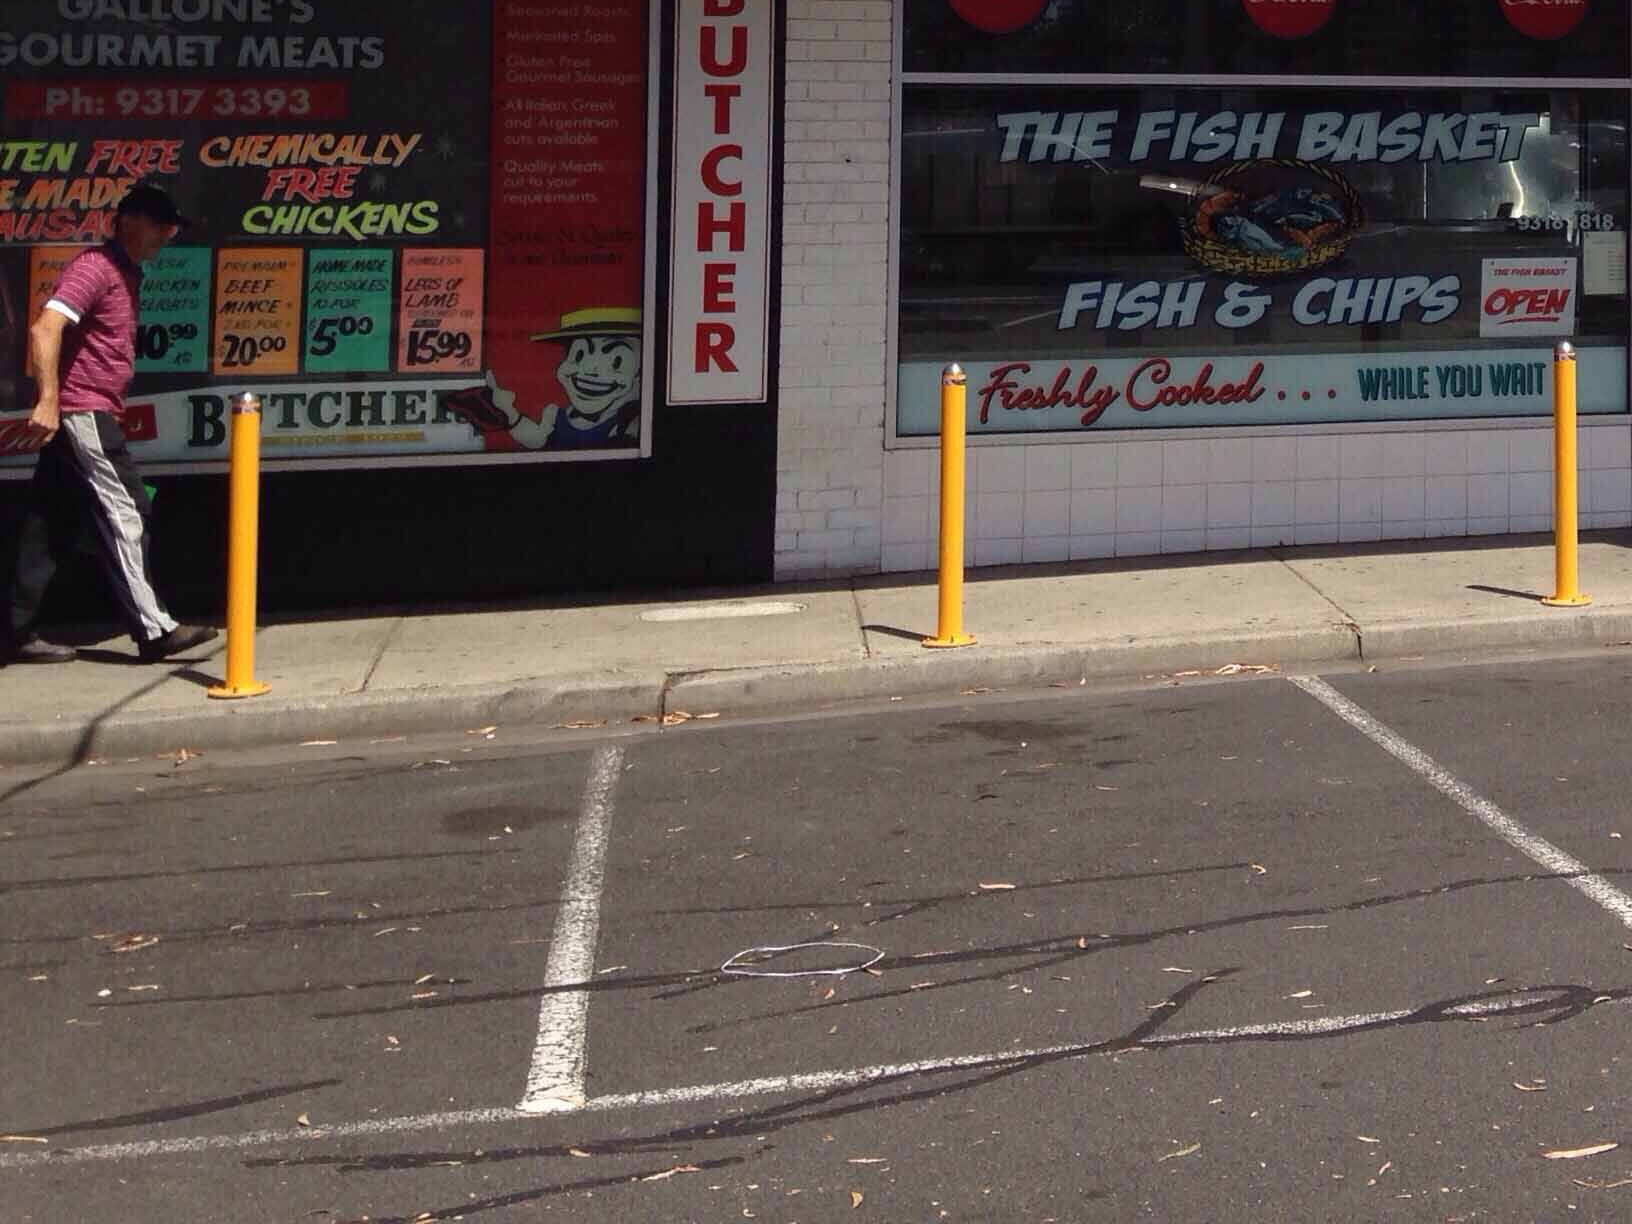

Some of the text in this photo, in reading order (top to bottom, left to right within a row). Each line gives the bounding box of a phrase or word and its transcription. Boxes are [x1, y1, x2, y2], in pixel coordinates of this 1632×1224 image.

[237, 36, 386, 70] MEATS
[45, 87, 312, 117] Ph: 9317 3393
[504, 116, 532, 129] and
[996, 110, 1540, 164] THE FISH BASKET
[0, 139, 185, 177] TEN FREE
[200, 132, 422, 169] CHEMICALLY
[503, 159, 556, 174] Quality
[262, 166, 363, 205] FREE
[241, 200, 440, 242] CHICKENS
[224, 280, 275, 294] BEEF
[1058, 275, 1461, 331] FISH & CHIPS
[1484, 287, 1571, 316] OPEN
[219, 299, 281, 314] MINCE
[978, 363, 1118, 427] Freshly
[1357, 367, 1429, 403] WHILE
[1436, 365, 1482, 399] YOU
[1489, 363, 1547, 397] WAIT
[187, 390, 472, 447] BTCHER
